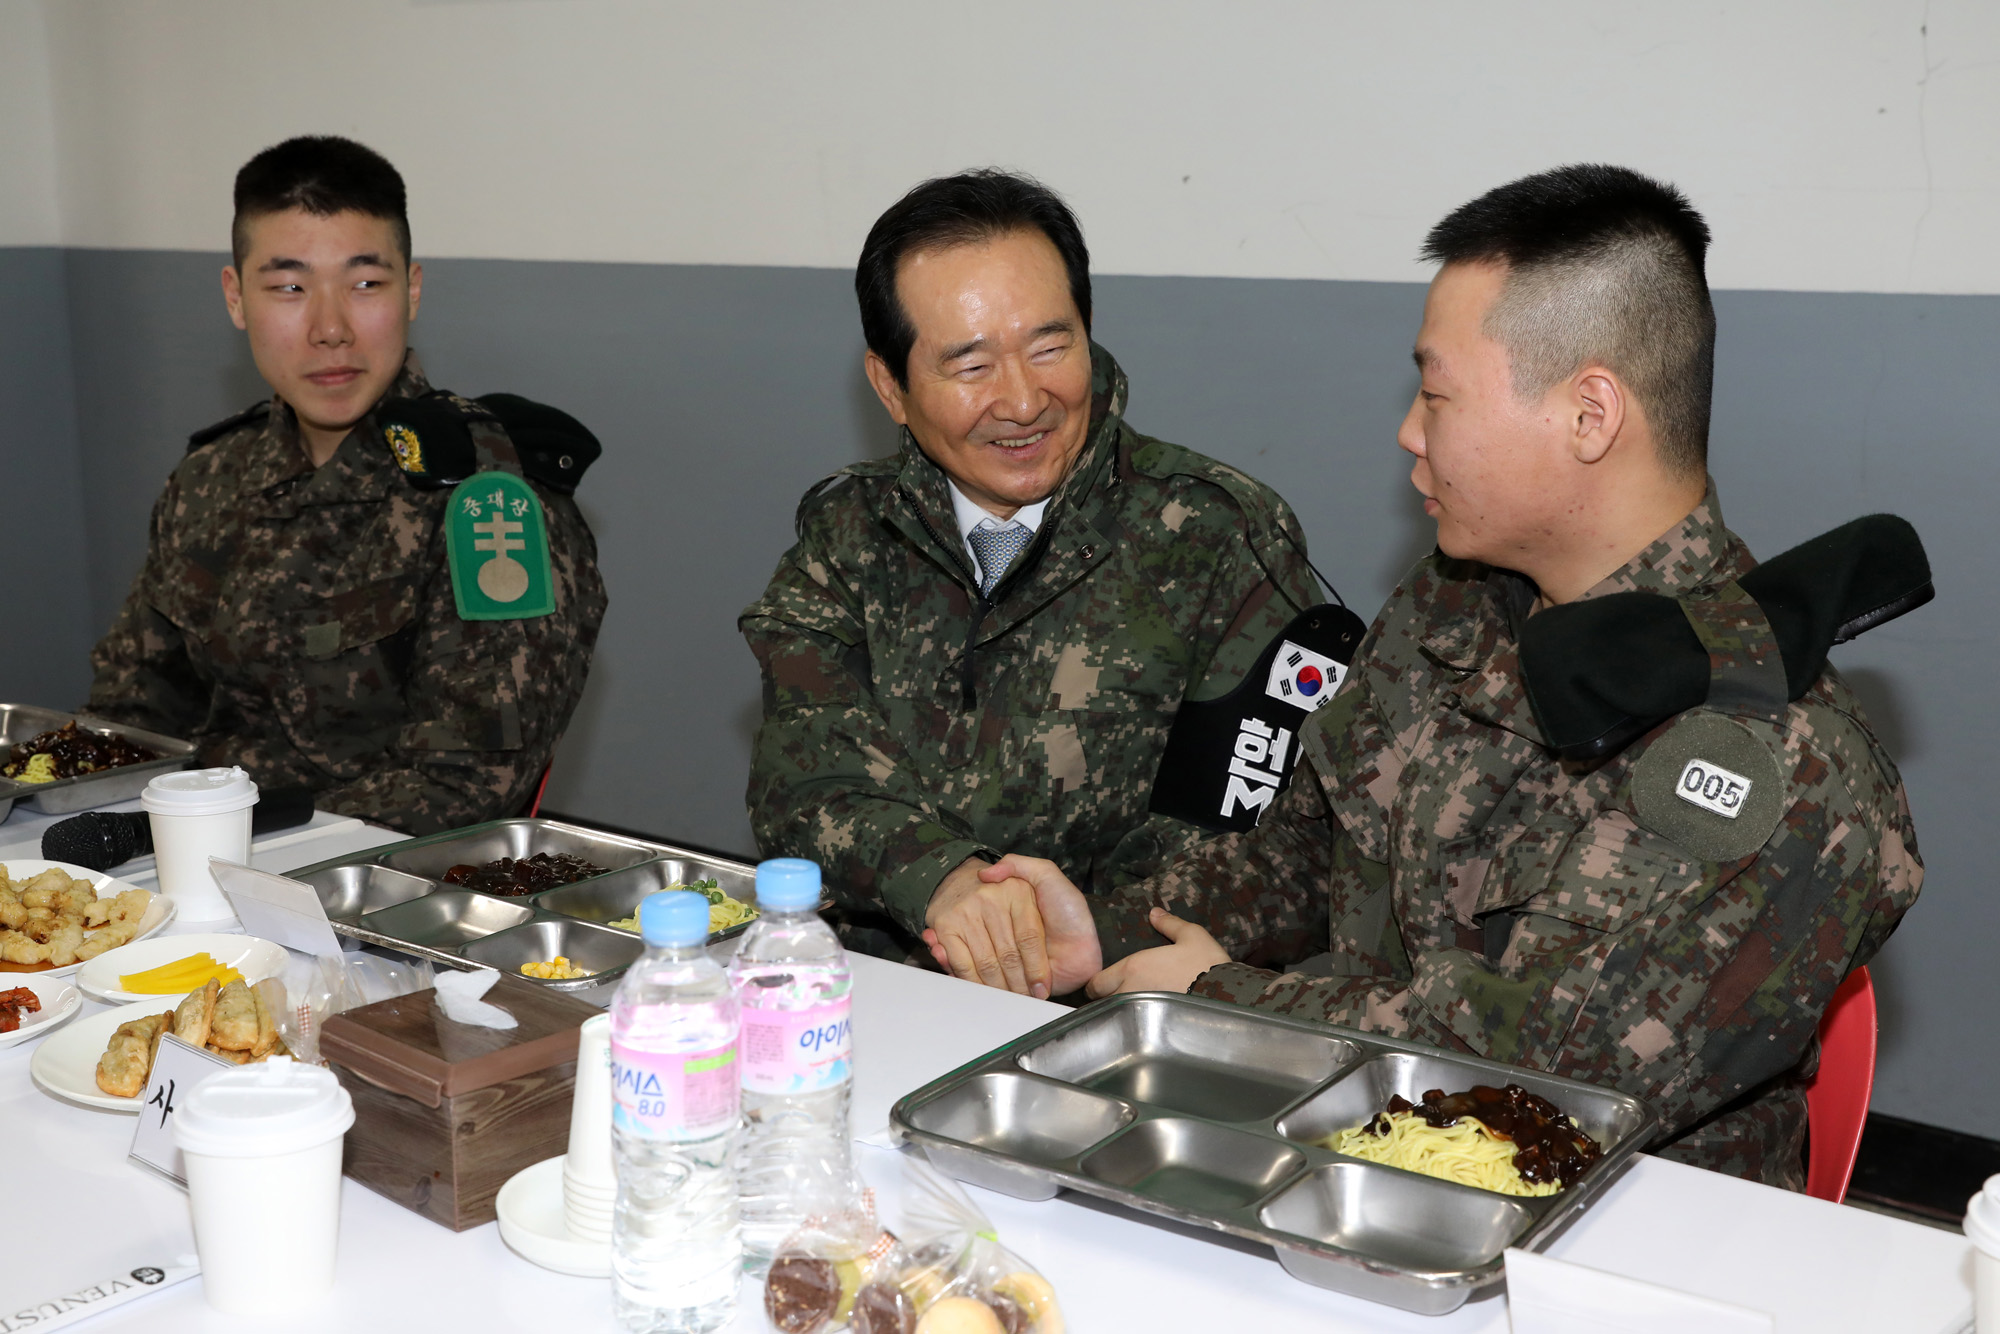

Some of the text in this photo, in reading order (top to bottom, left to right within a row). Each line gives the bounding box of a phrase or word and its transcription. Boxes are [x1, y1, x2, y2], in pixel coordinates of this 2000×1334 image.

[462, 488, 530, 517] 중대장
[1228, 718, 1304, 788] 헌
[1684, 766, 1745, 809] 005
[638, 1098, 666, 1118] 8.0
